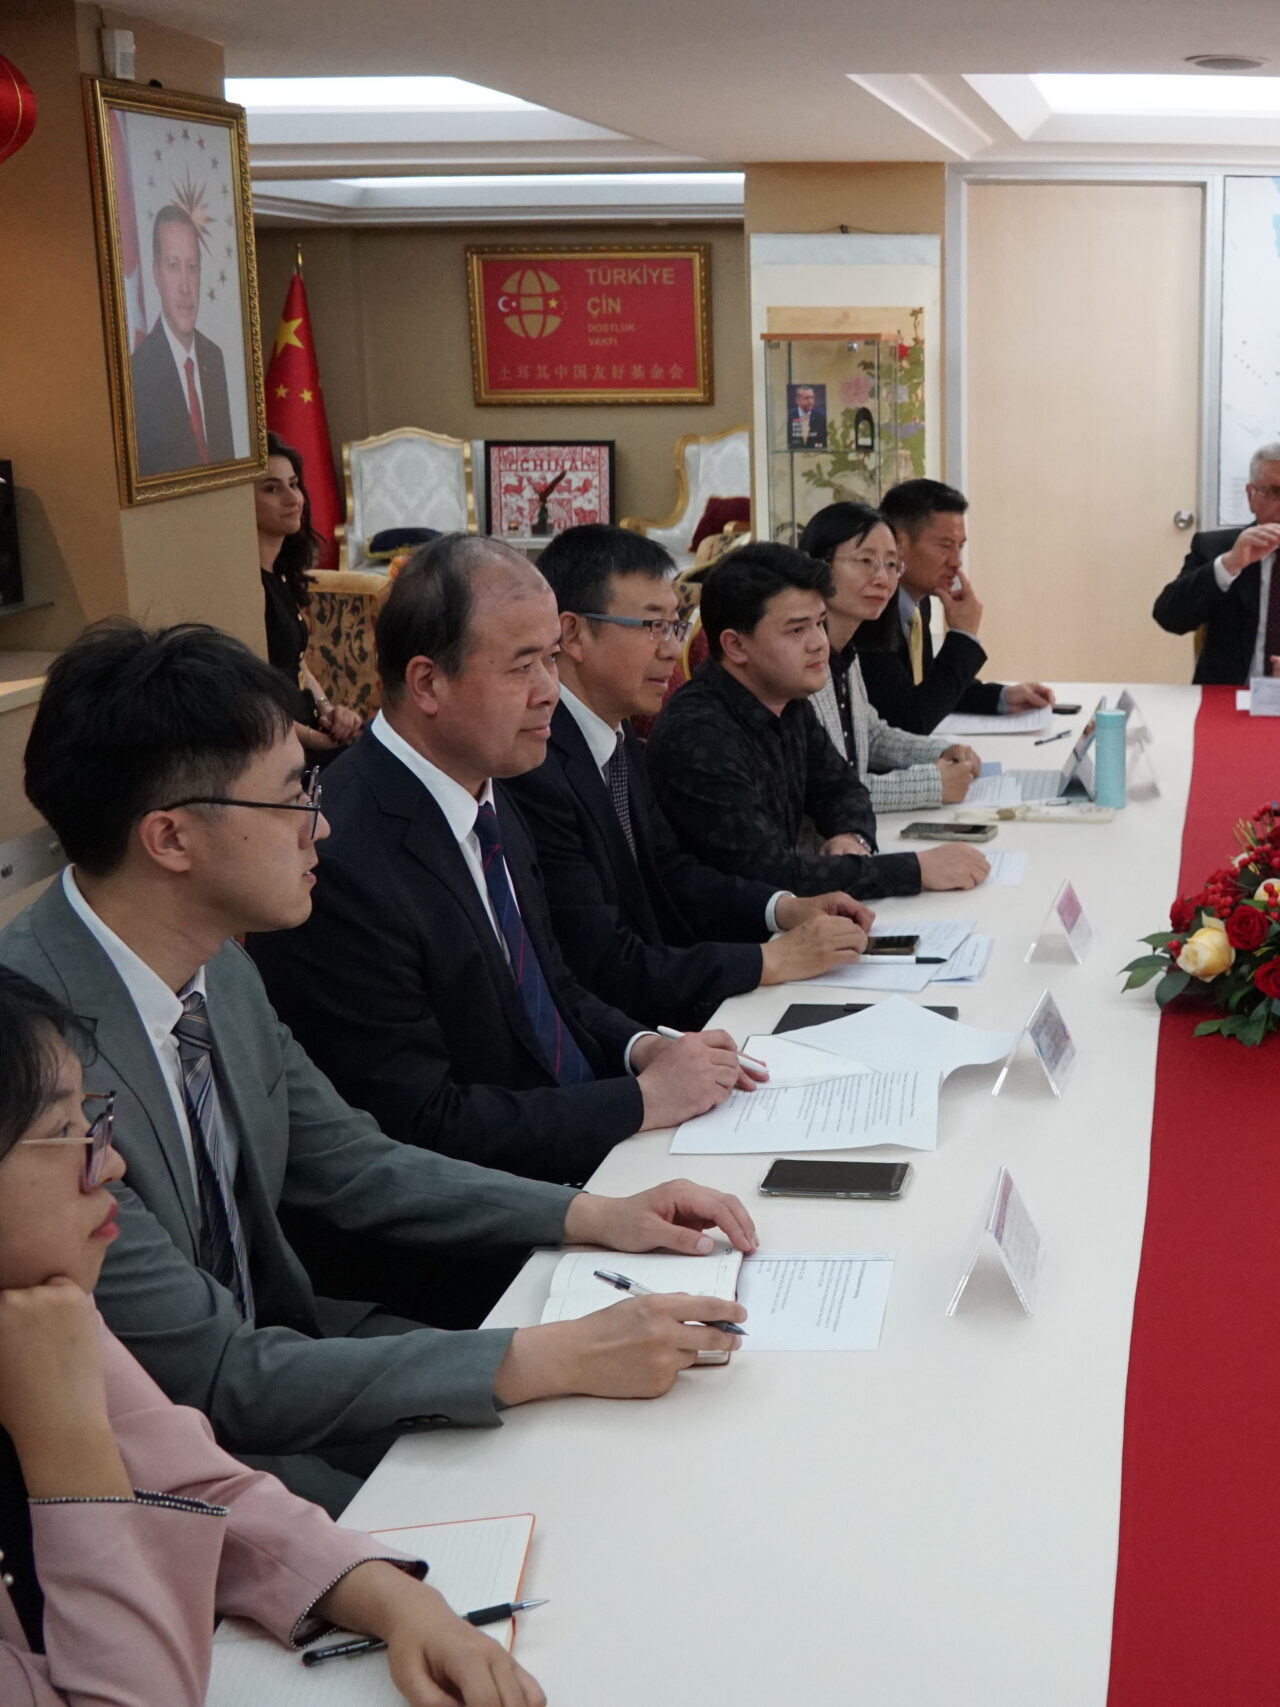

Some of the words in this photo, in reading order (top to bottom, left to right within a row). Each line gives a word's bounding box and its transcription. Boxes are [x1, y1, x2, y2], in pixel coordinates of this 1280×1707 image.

[585, 265, 675, 286] TÜRKİYE
[587, 294, 621, 317] ÇİN
[587, 323, 635, 333] DOSTLUK
[497, 363, 684, 382] 土耳其中国友好基金会
